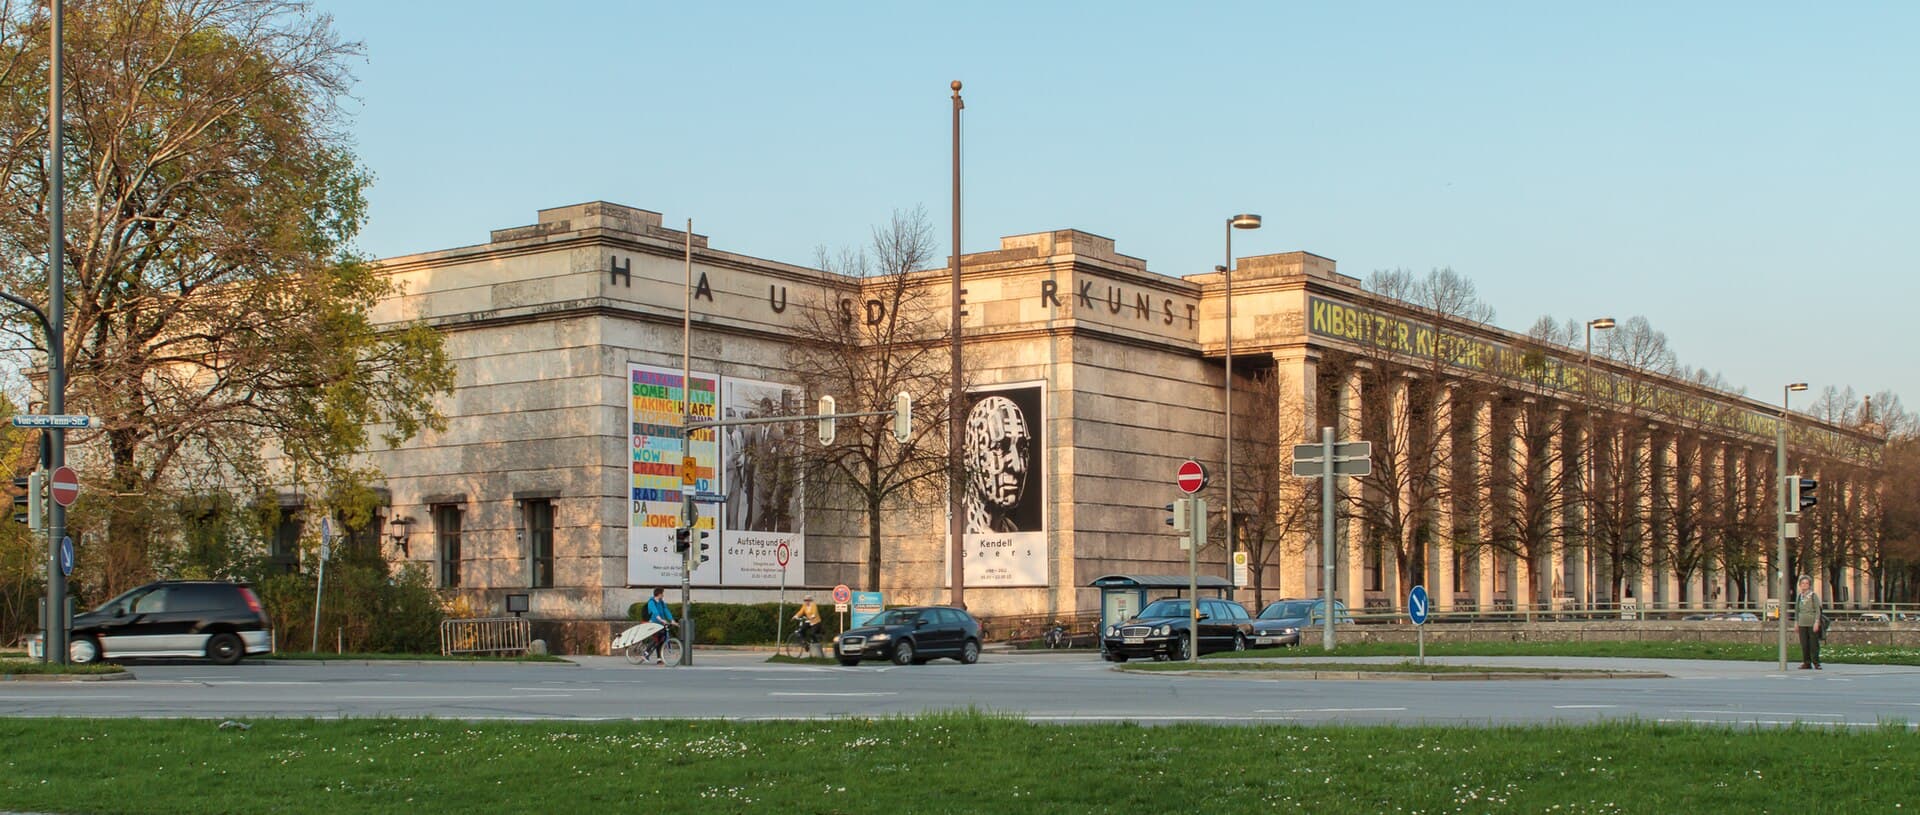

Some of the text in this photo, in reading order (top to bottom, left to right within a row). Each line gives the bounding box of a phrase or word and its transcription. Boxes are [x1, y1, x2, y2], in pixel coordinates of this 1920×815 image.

[610, 255, 853, 328] HAUS
[1079, 279, 1196, 330] KUNST
[678, 401, 716, 417] HART-
[728, 547, 744, 556] der
[980, 539, 1013, 548] Kendell
